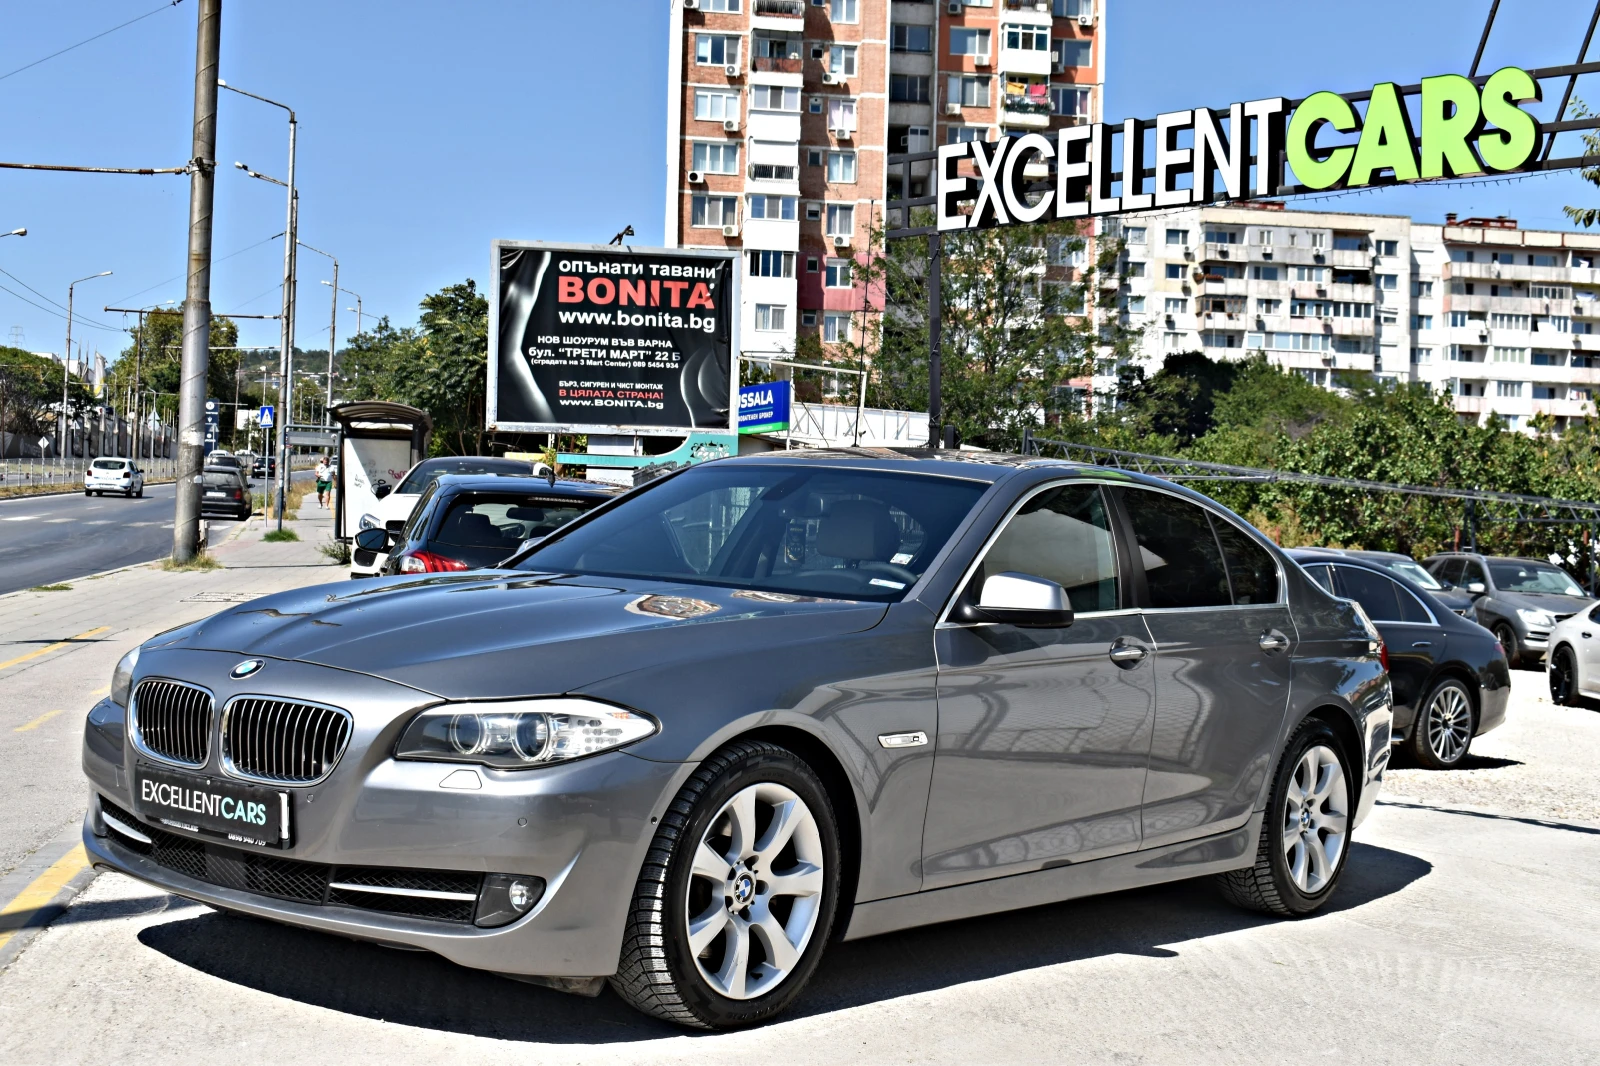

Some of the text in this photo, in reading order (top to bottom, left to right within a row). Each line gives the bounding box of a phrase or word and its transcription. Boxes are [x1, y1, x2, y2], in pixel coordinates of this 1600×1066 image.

[559, 260, 716, 279] опънати тавани
[558, 275, 715, 310] BONITA
[558, 309, 716, 333] www.bonita.bg
[537, 335, 673, 348] НОВ ШОУРУМ ВЪВ ВАРНА
[528, 346, 555, 359] бул.
[654, 351, 669, 361] 22
[672, 352, 681, 361] Б
[530, 357, 568, 367] (сградата
[604, 360, 631, 368] Center)
[558, 380, 579, 389] БЪРЗ,
[580, 381, 610, 389] СИГУРЕН
[617, 382, 634, 390] ЧИСТ
[634, 382, 664, 390] МОНТАЖ
[558, 389, 664, 399] В ЦЯЛАТА СТРАНА!
[559, 399, 664, 410] www.BONITA.bg
[142, 779, 267, 826] EXCELLENTCARS
